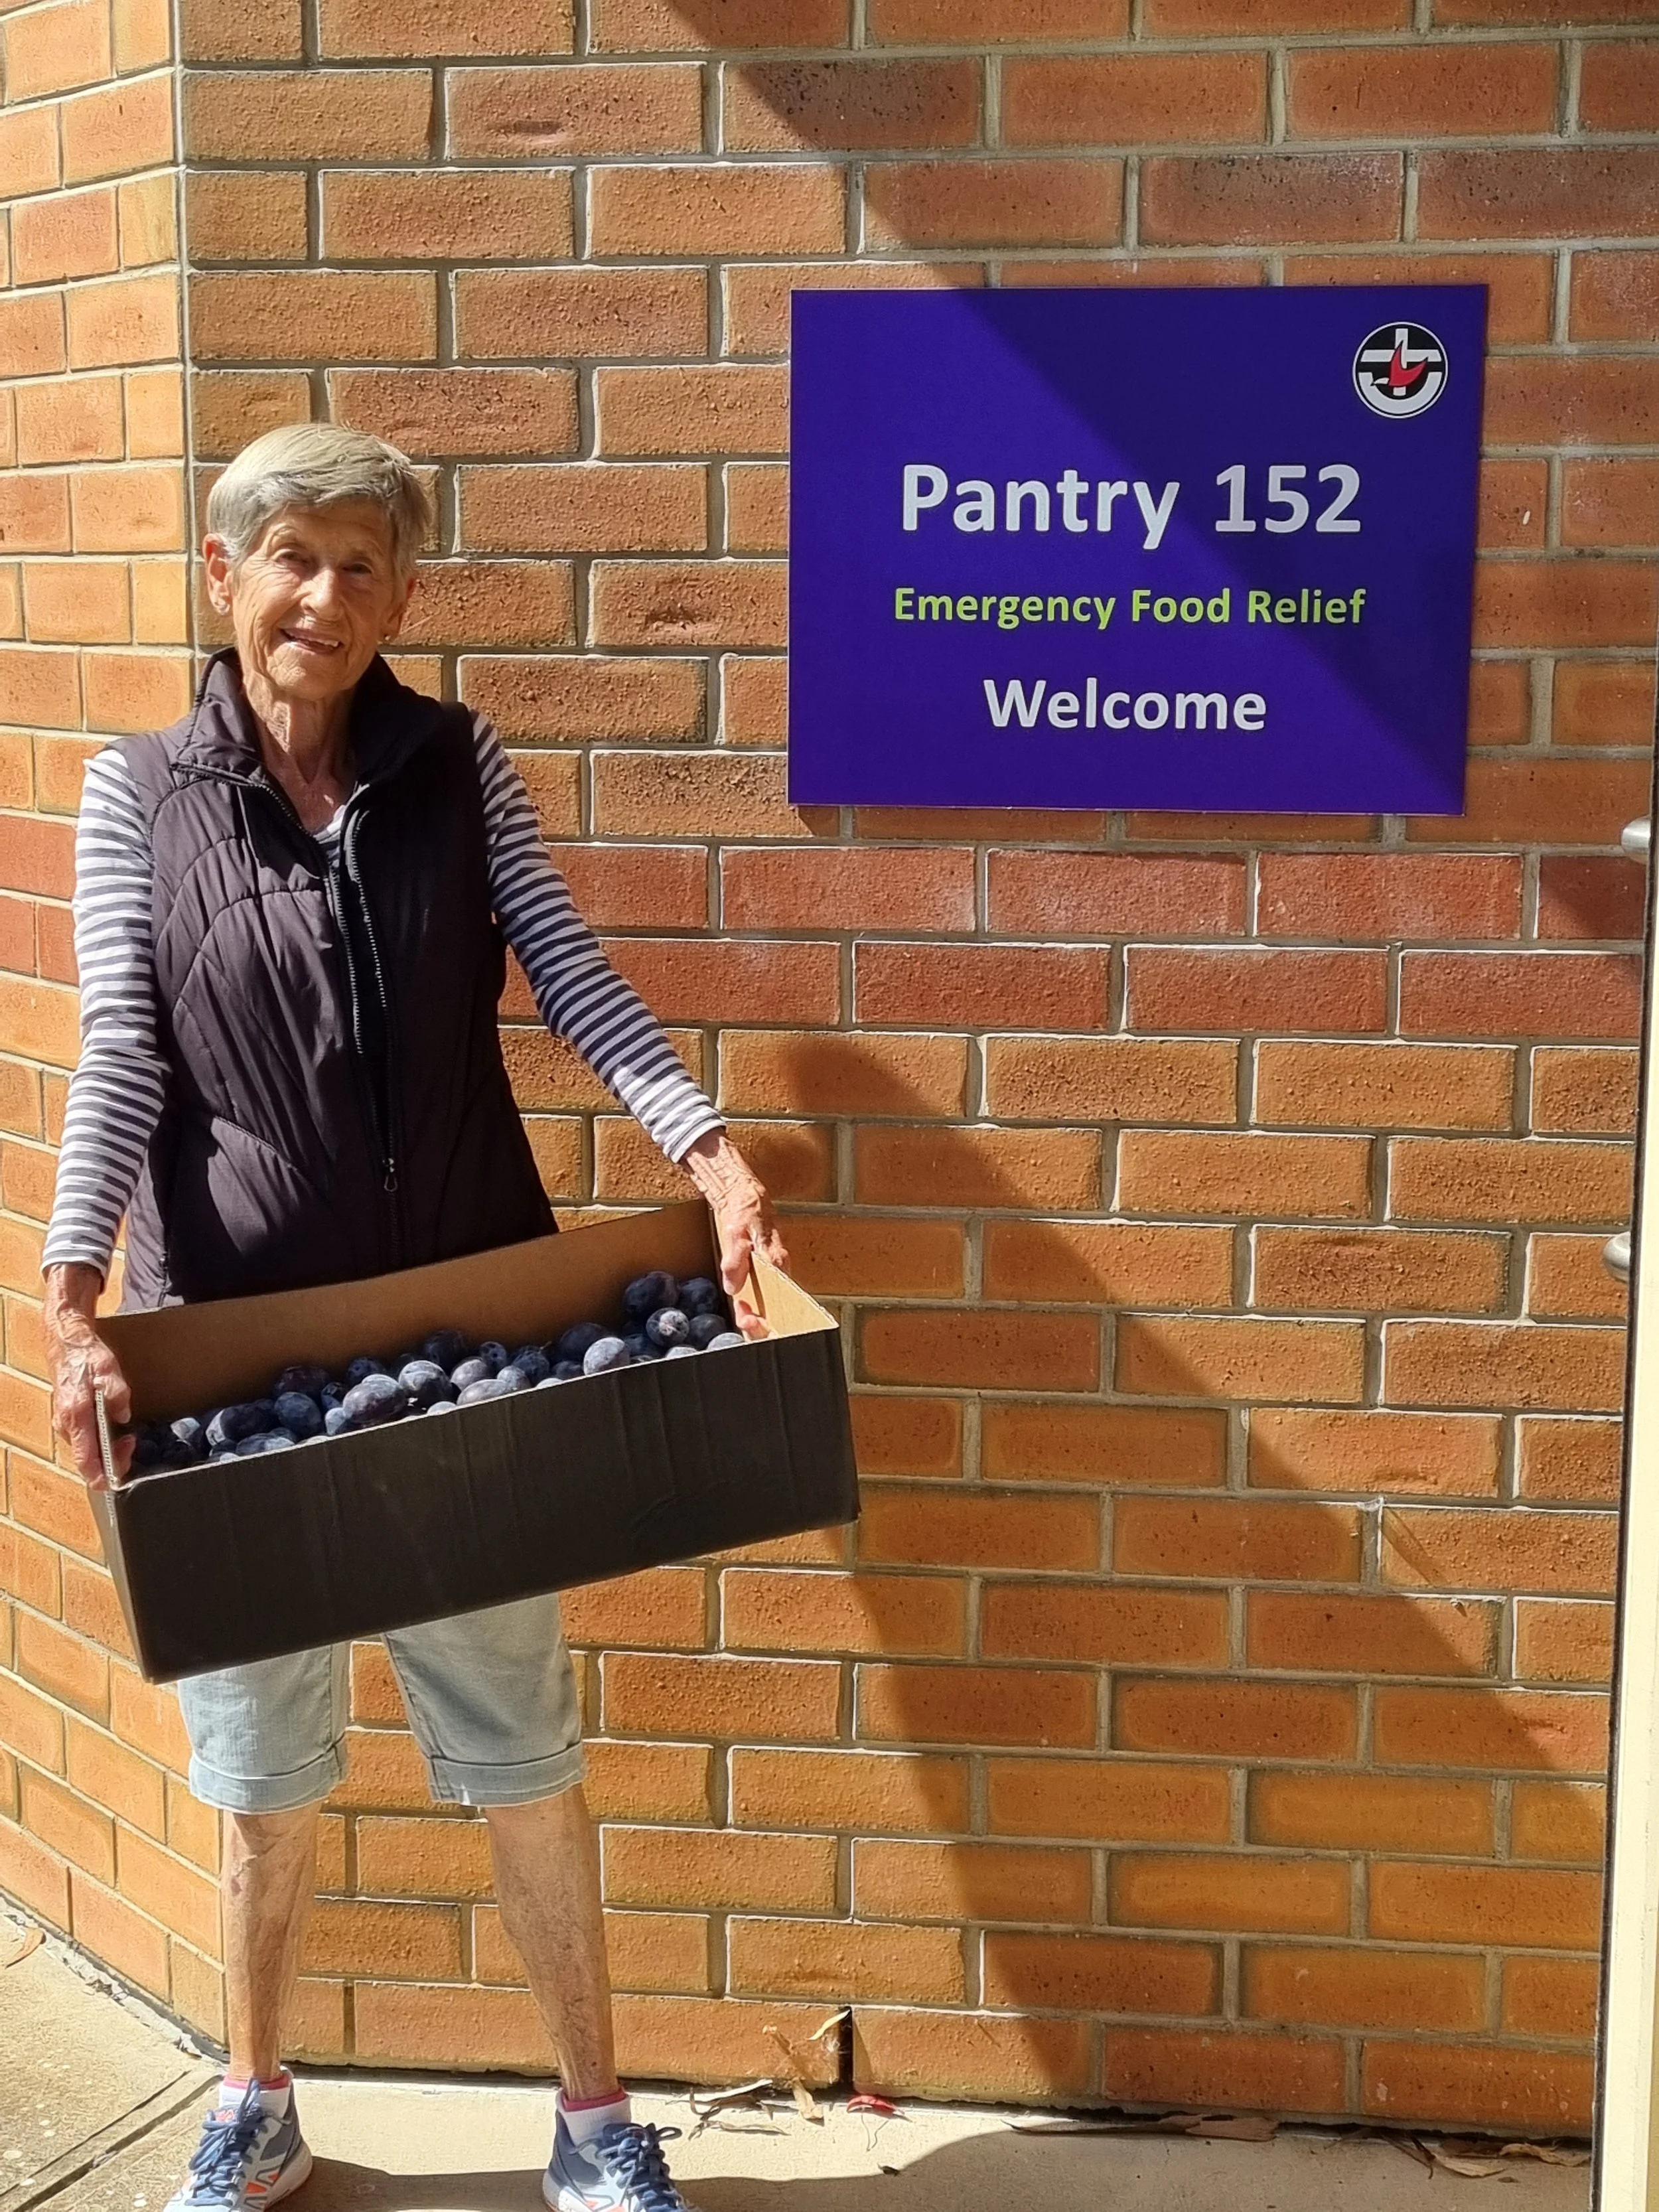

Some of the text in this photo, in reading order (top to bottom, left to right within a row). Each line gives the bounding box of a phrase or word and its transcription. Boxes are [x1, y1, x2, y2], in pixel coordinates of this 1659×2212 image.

[902, 463, 1362, 550] Pantry 152
[894, 587, 1367, 630] Emergency Food Relief
[982, 677, 1267, 731] Welcome
